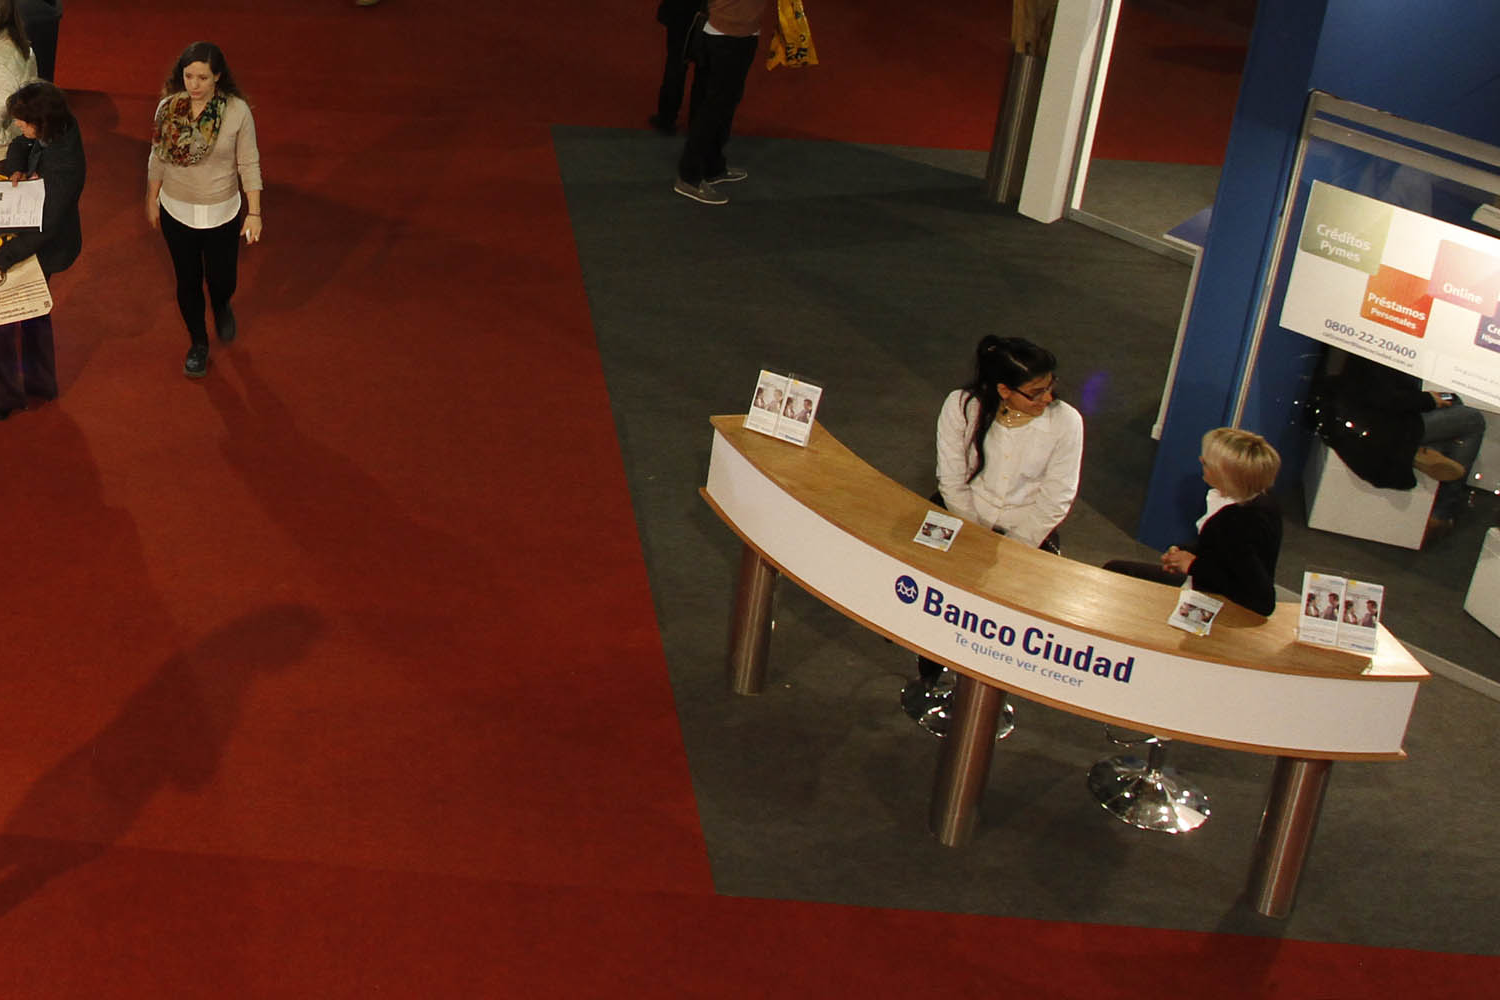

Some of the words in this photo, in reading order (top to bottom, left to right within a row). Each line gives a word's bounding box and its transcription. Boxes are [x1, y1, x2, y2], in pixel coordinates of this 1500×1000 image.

[1316, 224, 1372, 251] Créditos
[1320, 240, 1361, 264] Pymes
[1368, 291, 1426, 321] Préstamos
[1443, 282, 1484, 305] Online
[1370, 307, 1417, 330] Personales
[1324, 318, 1417, 360] 0800-22-20400
[923, 586, 1017, 647] Banco
[1022, 627, 1136, 684] Ciudad
[954, 632, 968, 647] Te
[971, 640, 1014, 665] quiere
[1016, 657, 1038, 673] ver
[1040, 667, 1085, 689] crecer
